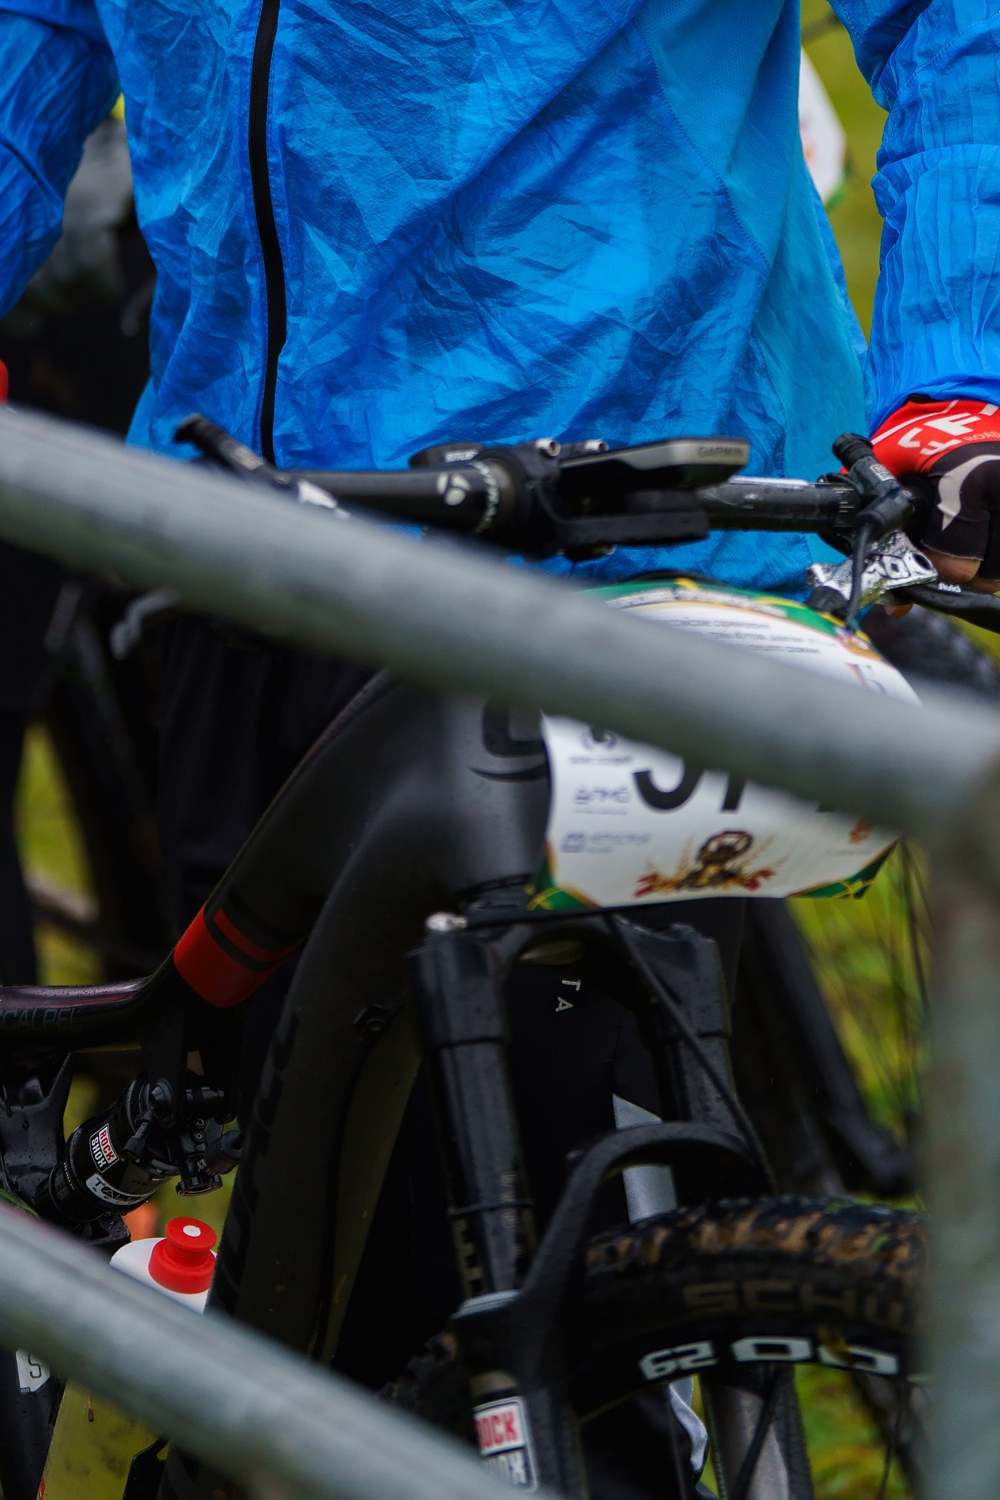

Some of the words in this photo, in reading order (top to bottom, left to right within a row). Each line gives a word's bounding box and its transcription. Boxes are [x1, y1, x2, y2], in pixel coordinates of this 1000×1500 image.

[91, 1136, 107, 1168] SHOX
[99, 1129, 116, 1161] ROCK
[476, 1412, 519, 1448] OCK
